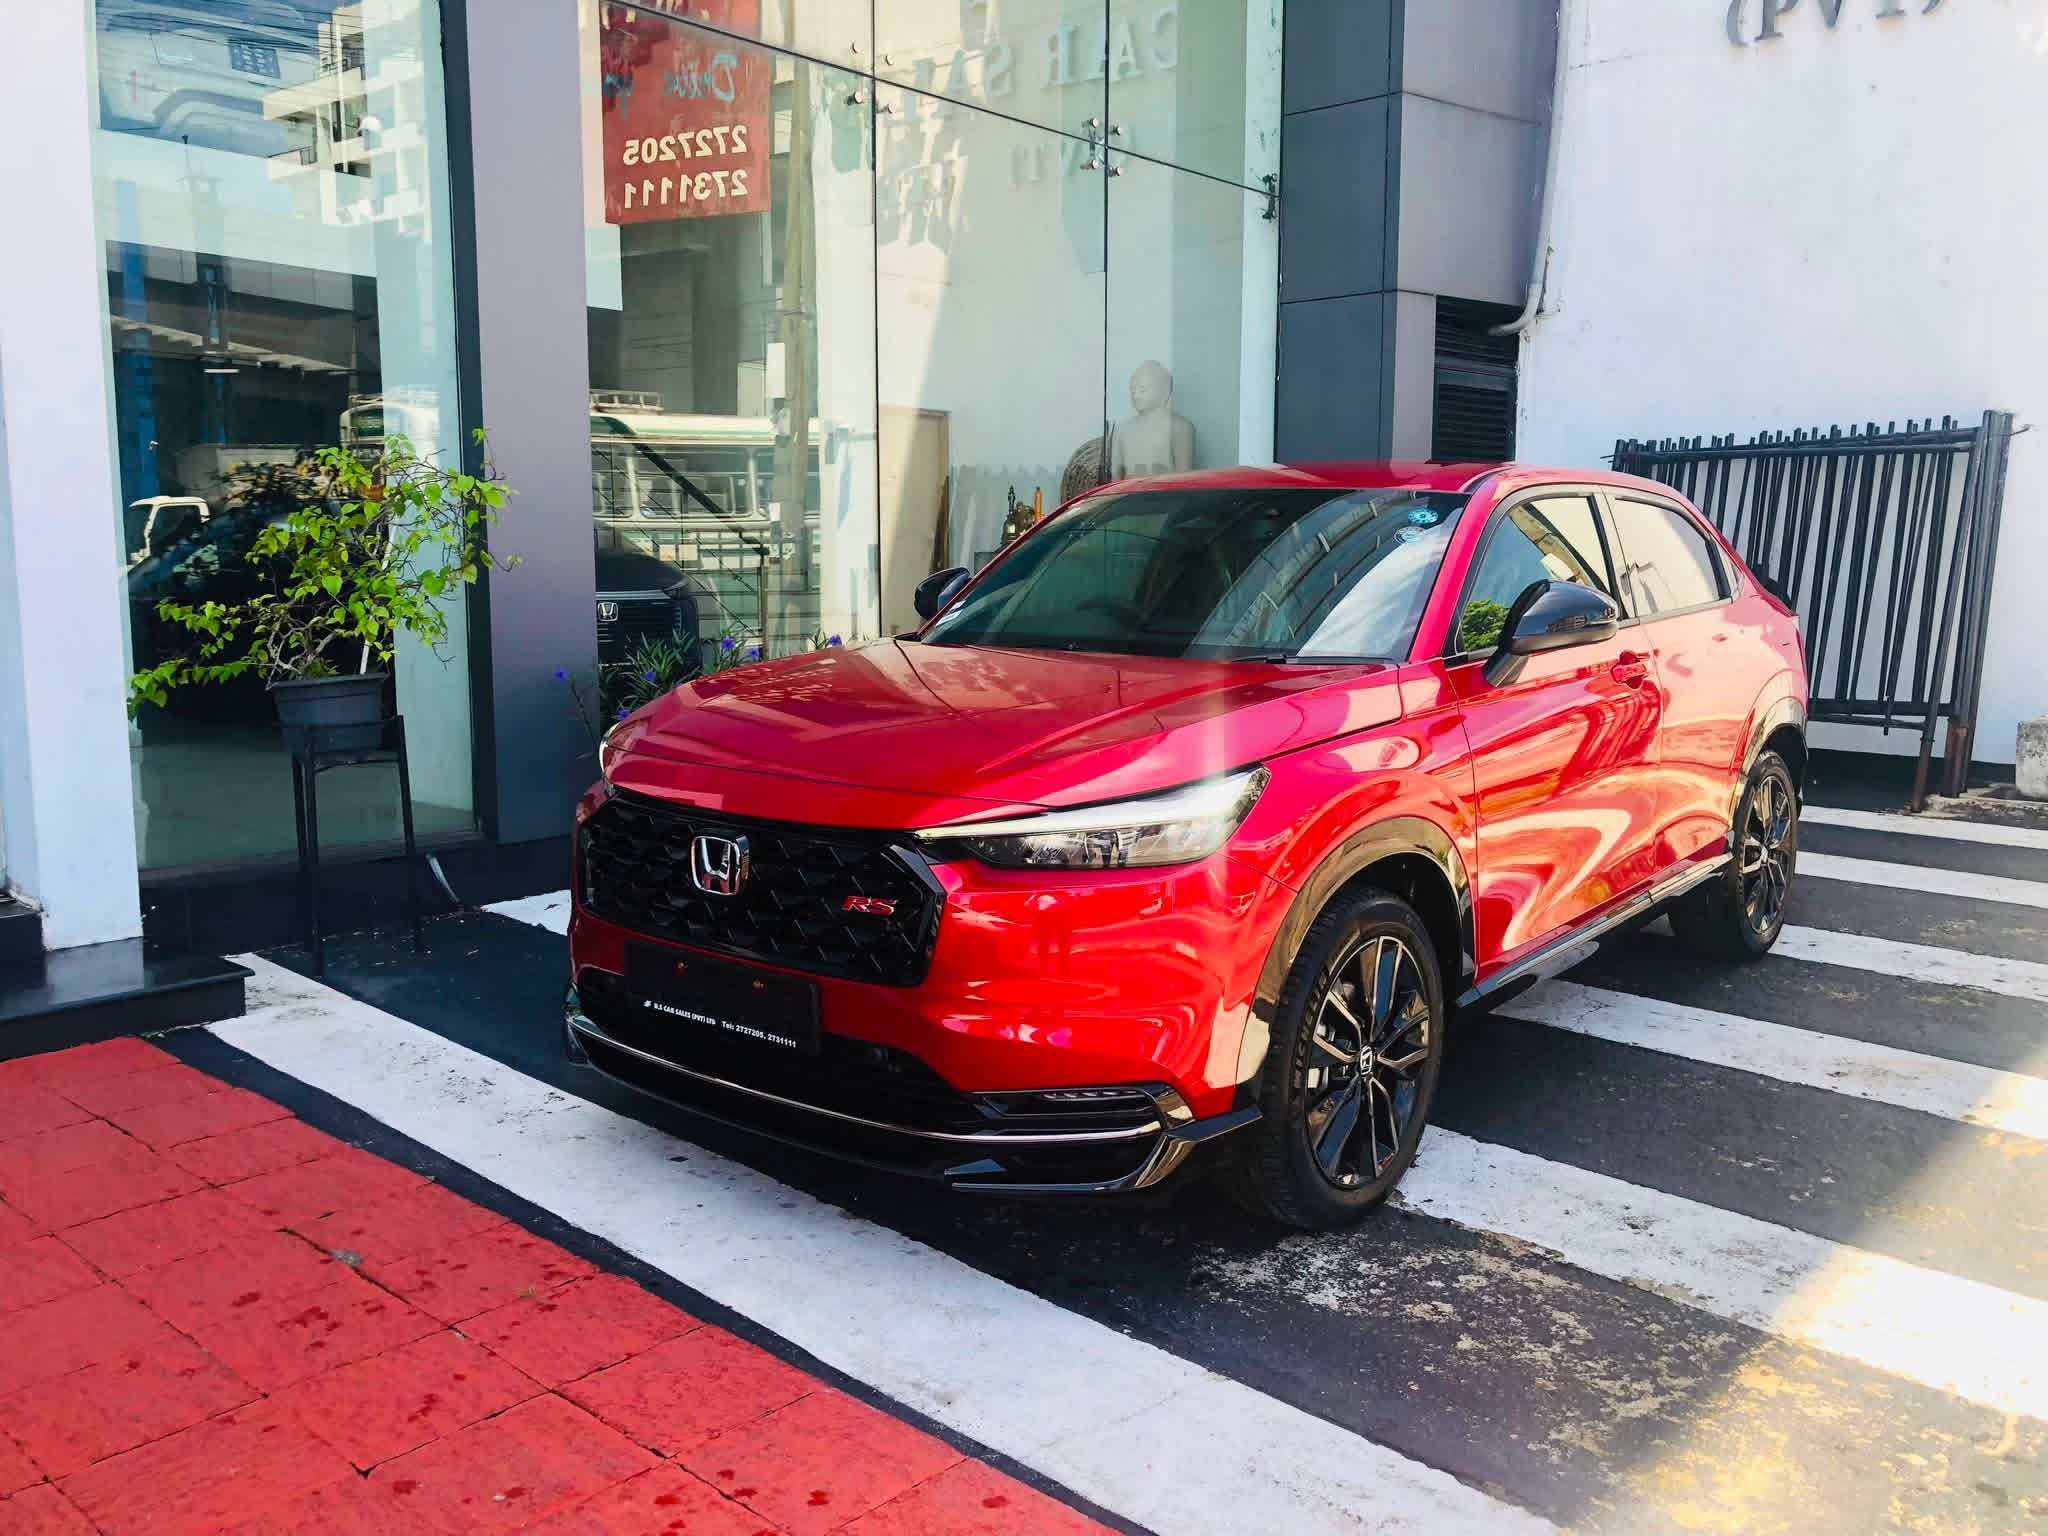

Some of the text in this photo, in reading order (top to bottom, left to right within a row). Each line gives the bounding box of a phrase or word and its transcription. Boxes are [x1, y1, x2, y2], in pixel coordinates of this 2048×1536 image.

[842, 896, 896, 915] RS
[663, 1005, 675, 1015] CAR
[675, 1008, 691, 1020] SALES
[735, 1024, 767, 1040] 2727205,
[767, 1033, 797, 1049] 2731111
